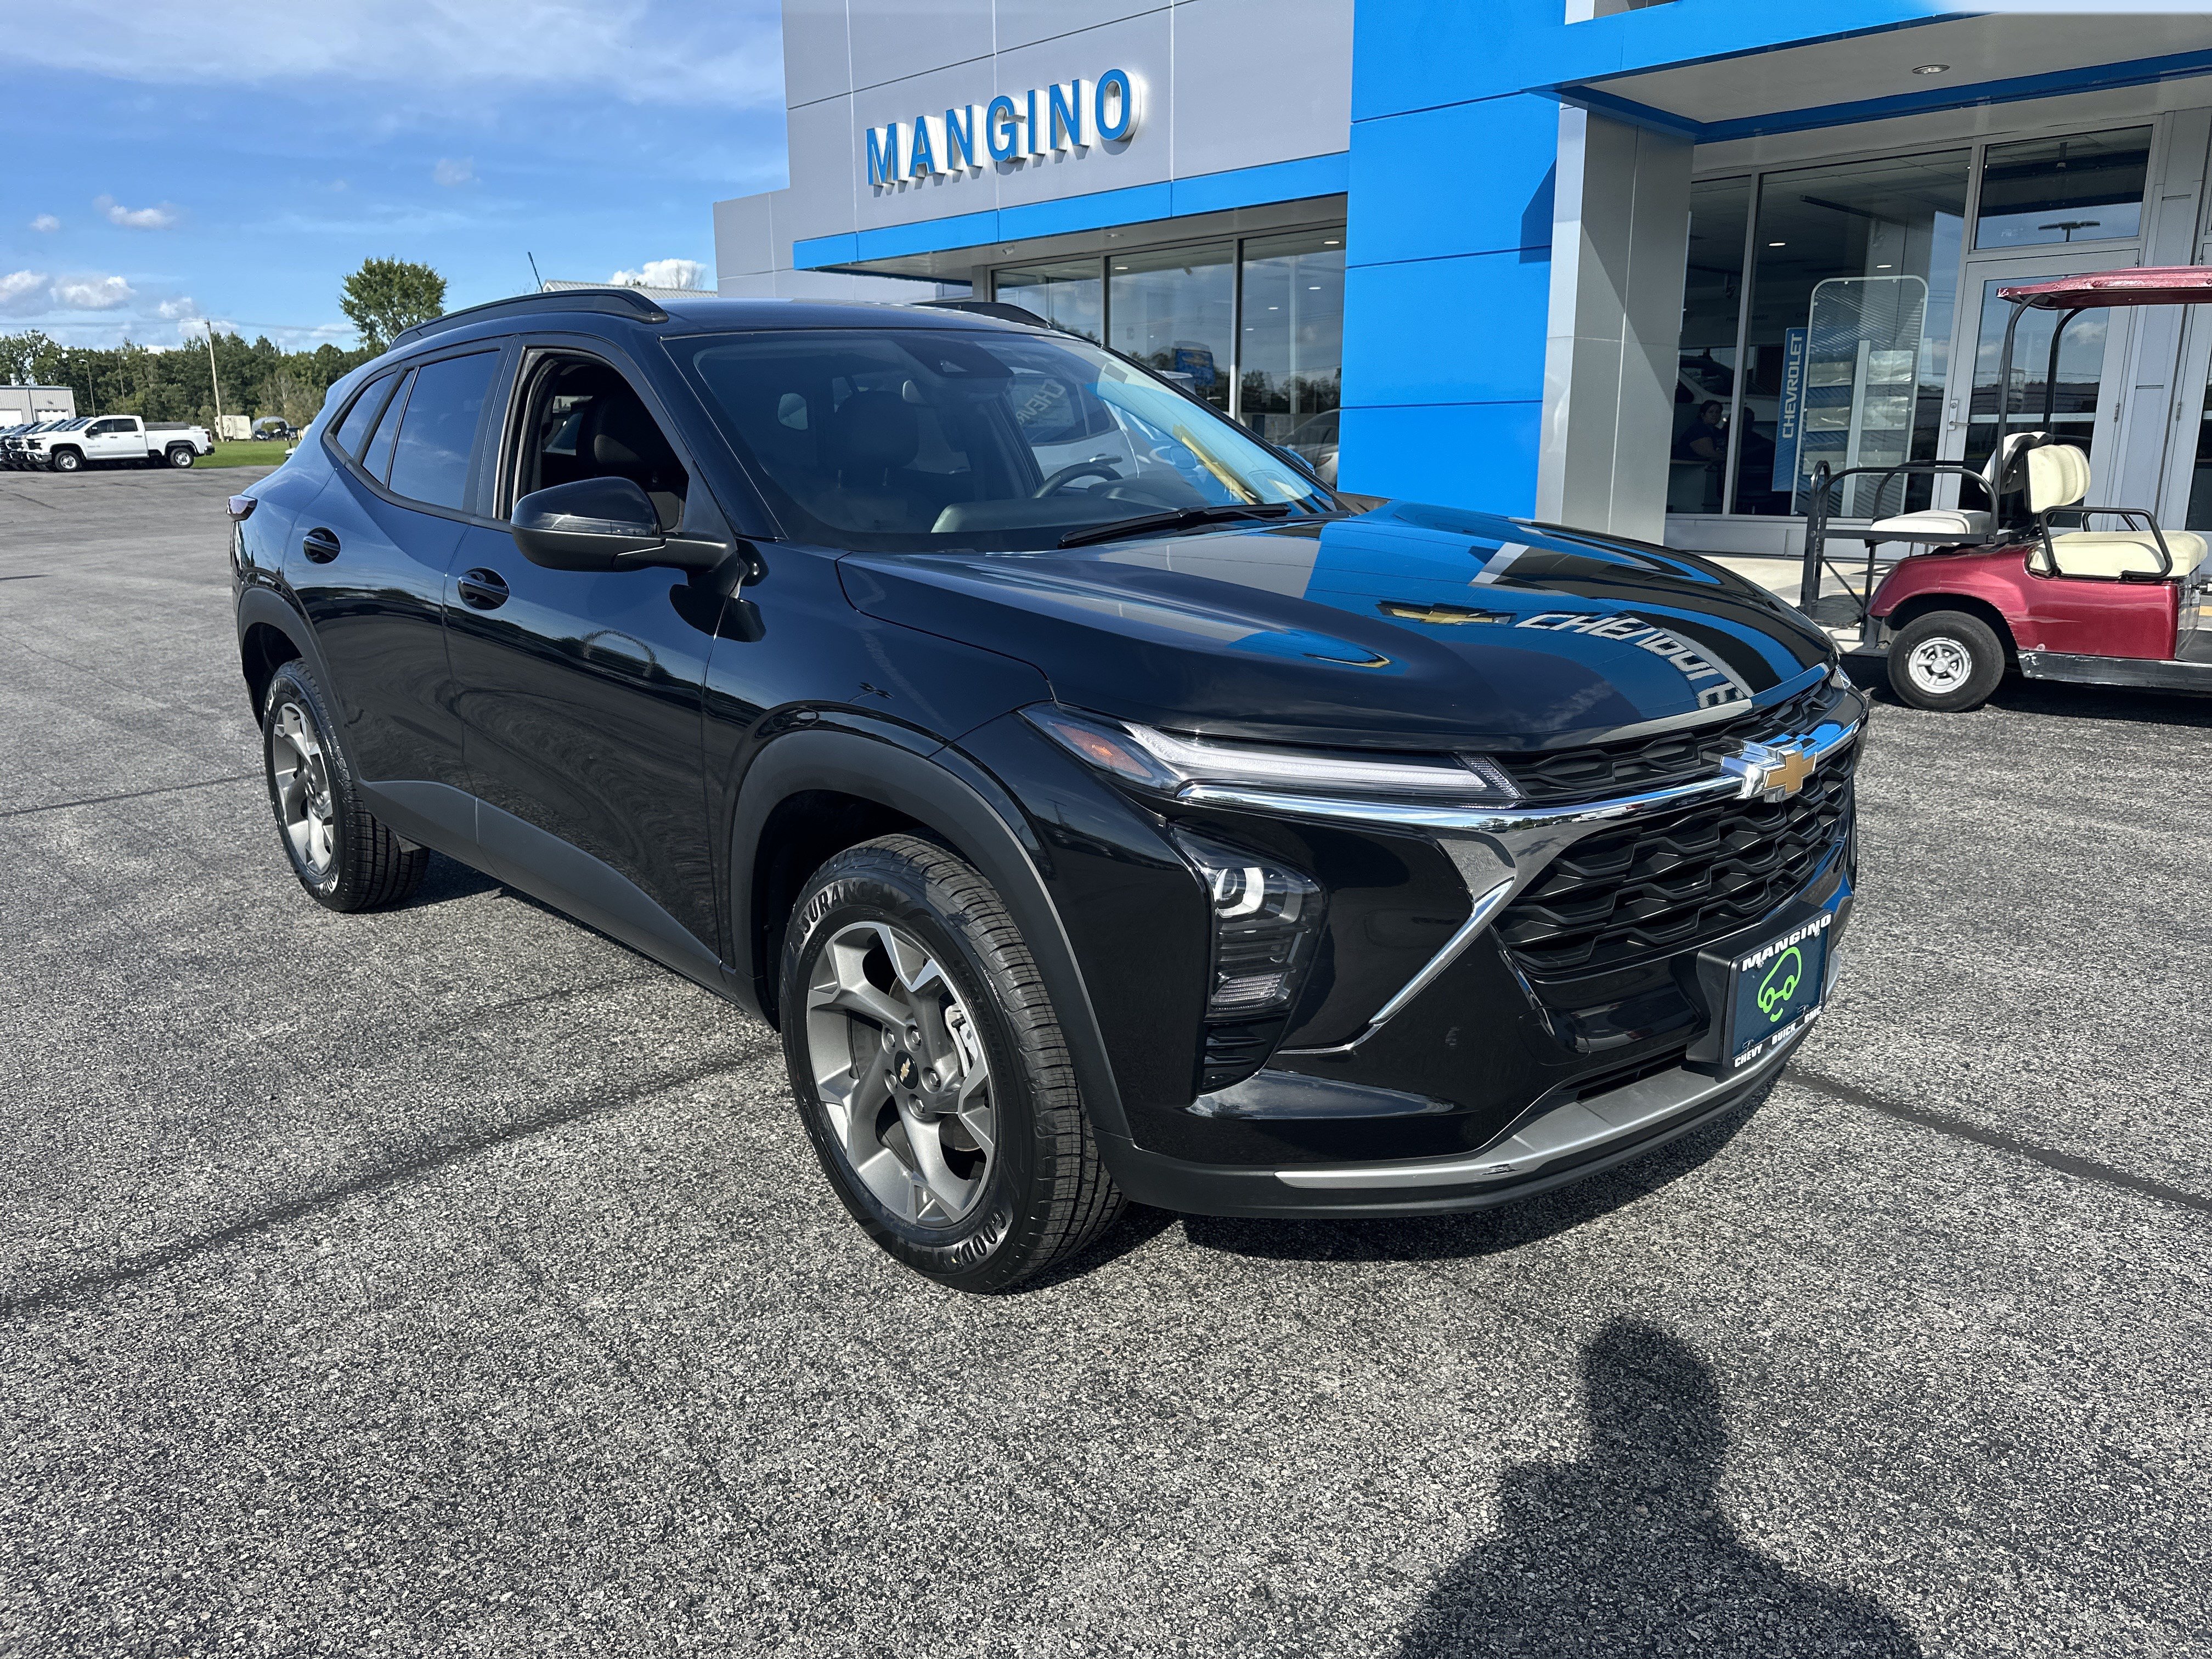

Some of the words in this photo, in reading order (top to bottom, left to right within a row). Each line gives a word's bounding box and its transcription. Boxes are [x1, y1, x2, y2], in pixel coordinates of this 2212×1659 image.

[866, 69, 1140, 187] MANGINO
[1782, 333, 1803, 438] CHEVROLET
[1741, 913, 1831, 972] MANGINO
[1734, 1043, 1763, 1068] CHEVY
[1771, 1022, 1796, 1046] BUICK
[1804, 1006, 1822, 1024] GMC
